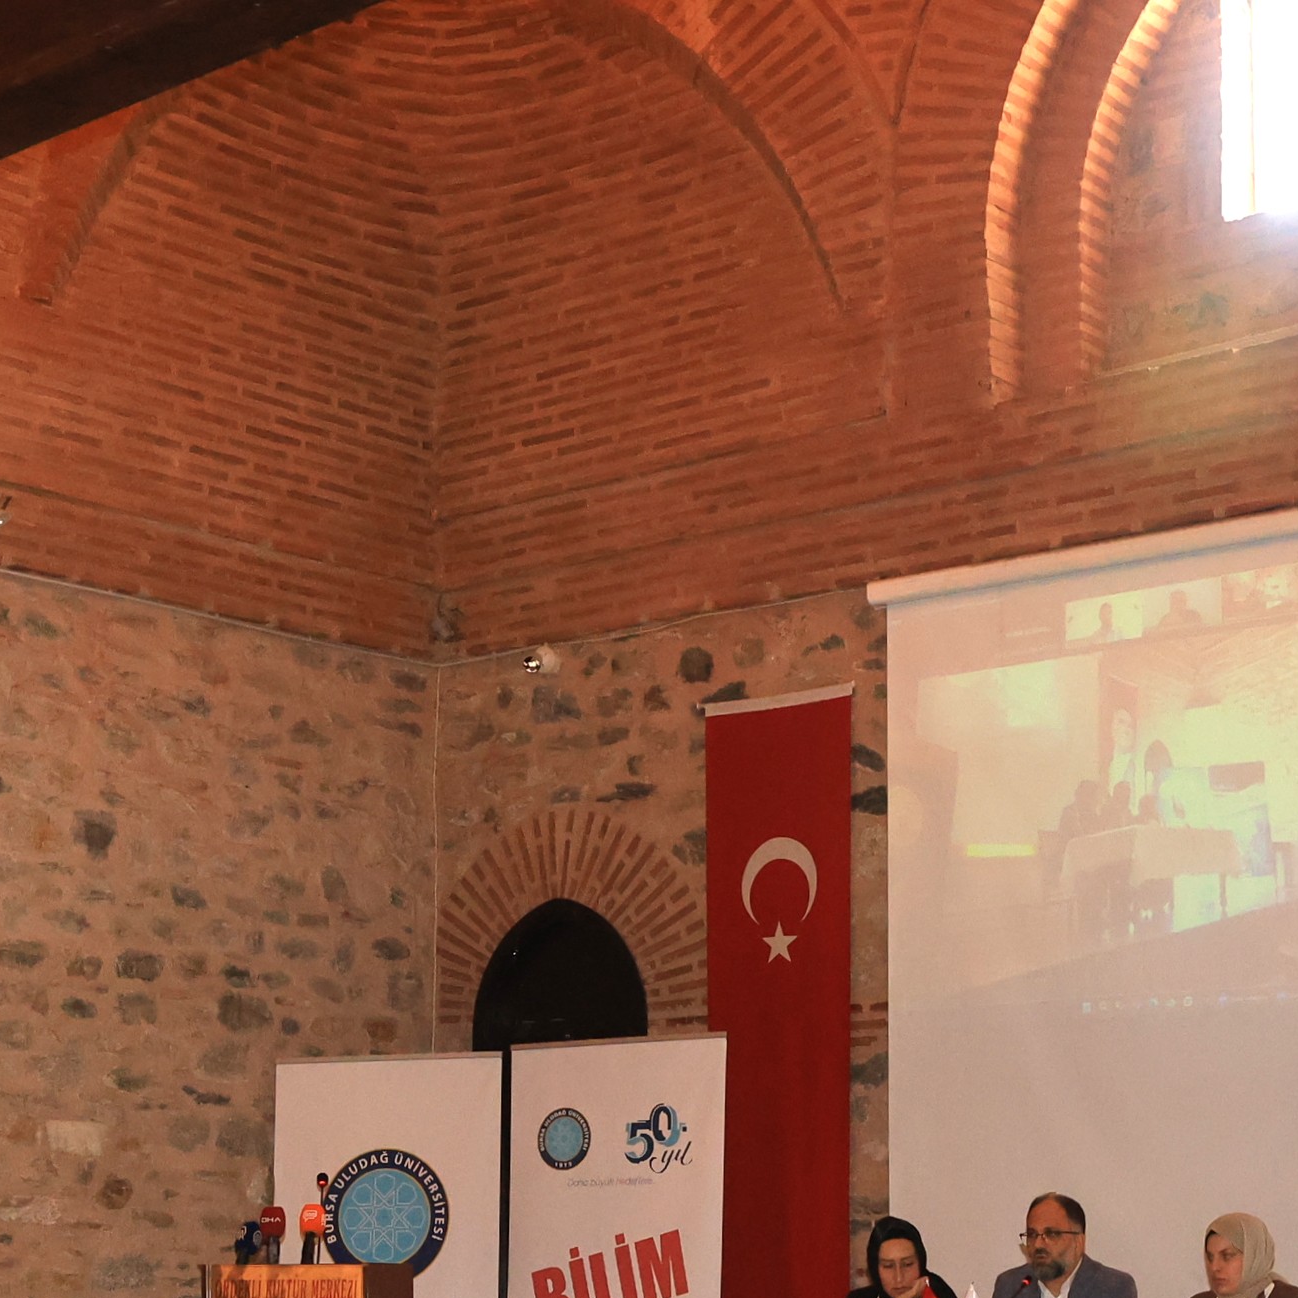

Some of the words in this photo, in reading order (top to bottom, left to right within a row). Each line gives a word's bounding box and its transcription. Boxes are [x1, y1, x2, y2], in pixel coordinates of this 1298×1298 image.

[649, 1141, 693, 1174] yıl
[325, 1194, 338, 1244] BURSA
[334, 1151, 389, 1190] ULUDAĞ
[393, 1151, 445, 1242] ÜNİVERSİTESİ
